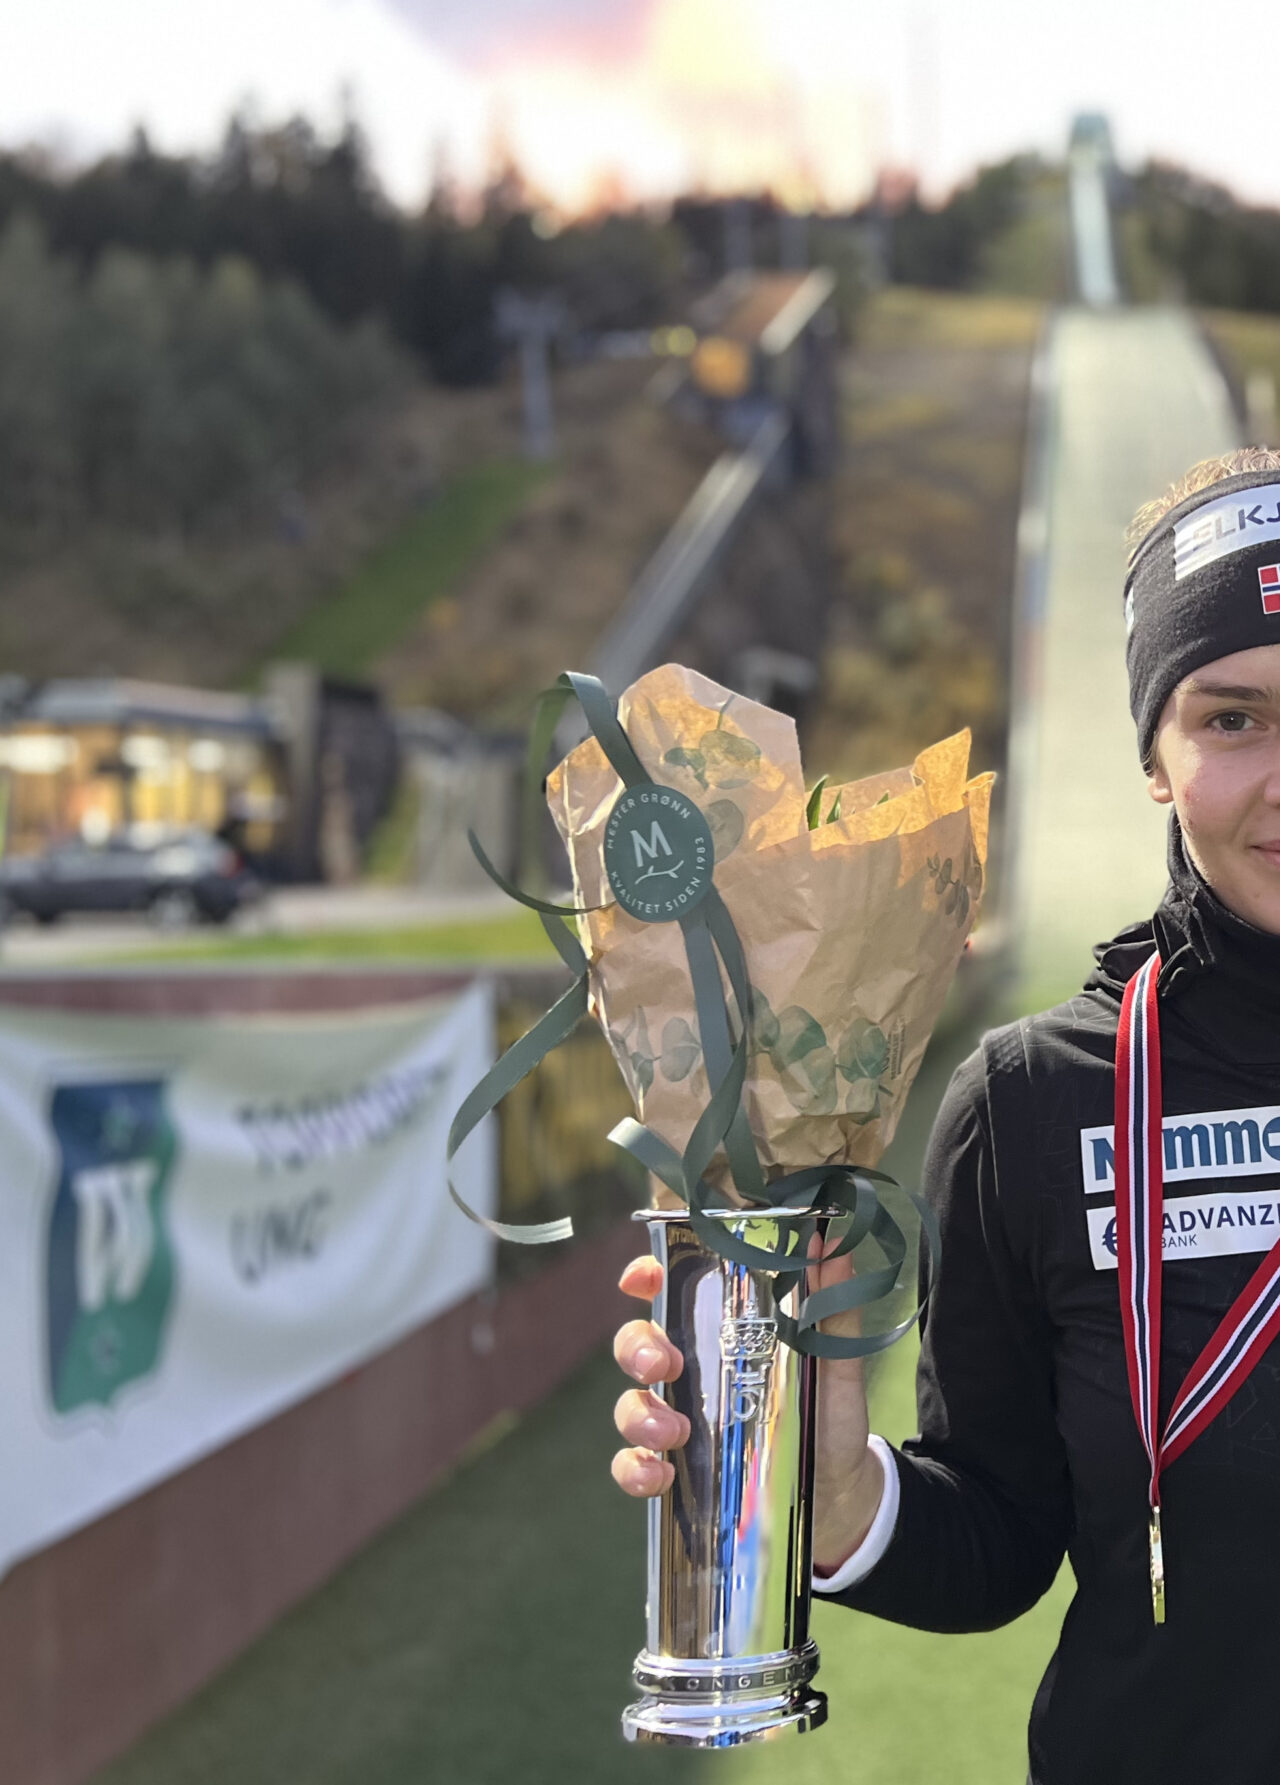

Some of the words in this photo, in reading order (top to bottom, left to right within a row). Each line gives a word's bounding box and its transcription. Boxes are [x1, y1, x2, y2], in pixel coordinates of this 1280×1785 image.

[641, 793, 691, 819] GRØNN
[630, 821, 673, 867] M
[610, 871, 660, 914] KVALITET
[665, 877, 701, 912] SIDEN
[1161, 1234, 1198, 1249] BANK
